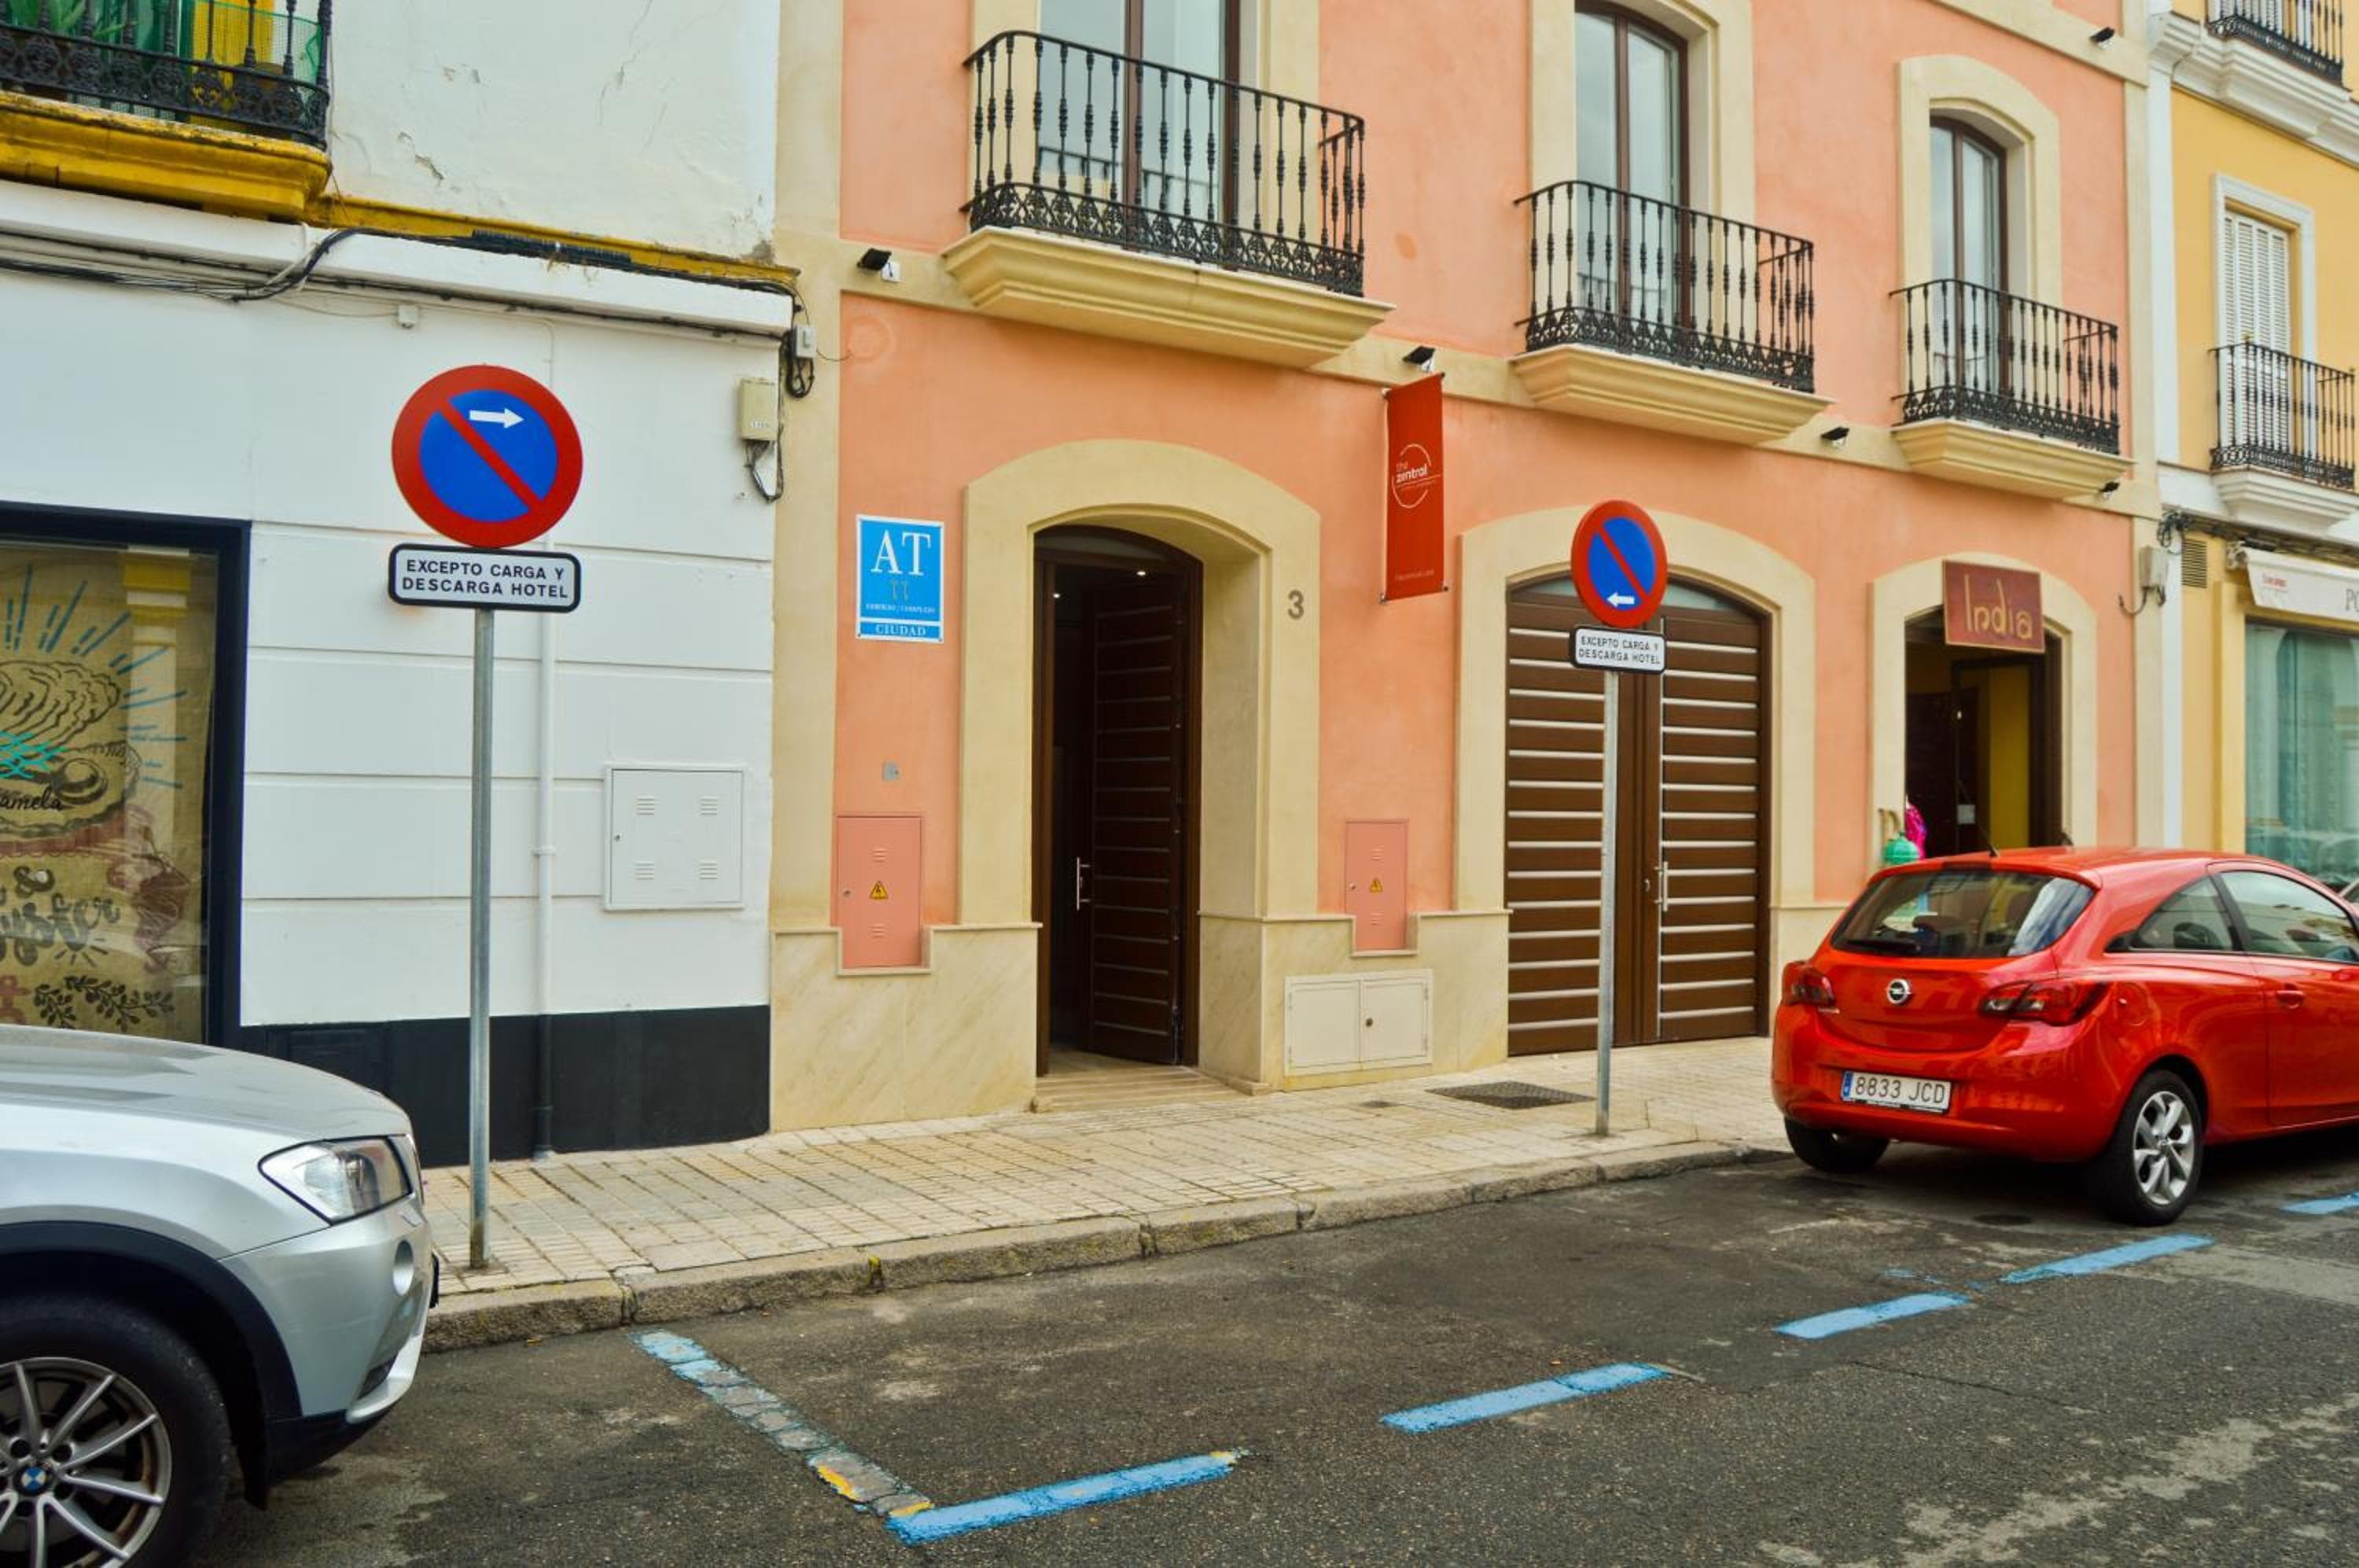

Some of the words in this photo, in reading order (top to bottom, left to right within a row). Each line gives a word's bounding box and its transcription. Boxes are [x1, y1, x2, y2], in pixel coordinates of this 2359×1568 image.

[870, 529, 932, 576] AT
[407, 559, 483, 576] EXCEPTO
[490, 564, 547, 580] CARGA
[555, 568, 564, 580] Y
[402, 577, 503, 595] DESCARGA
[511, 583, 569, 598] HOTEL
[1288, 589, 1305, 620] 3
[1964, 574, 2033, 639] India
[875, 624, 926, 636] CIUDAD
[1581, 635, 1619, 648] EXCEPTO
[1622, 639, 1651, 651] CARGA
[1578, 649, 1629, 661] DESCARGA
[1632, 654, 1661, 664] HOTEL
[1856, 1076, 1901, 1099] 8833
[1908, 1081, 1945, 1103] JCD
